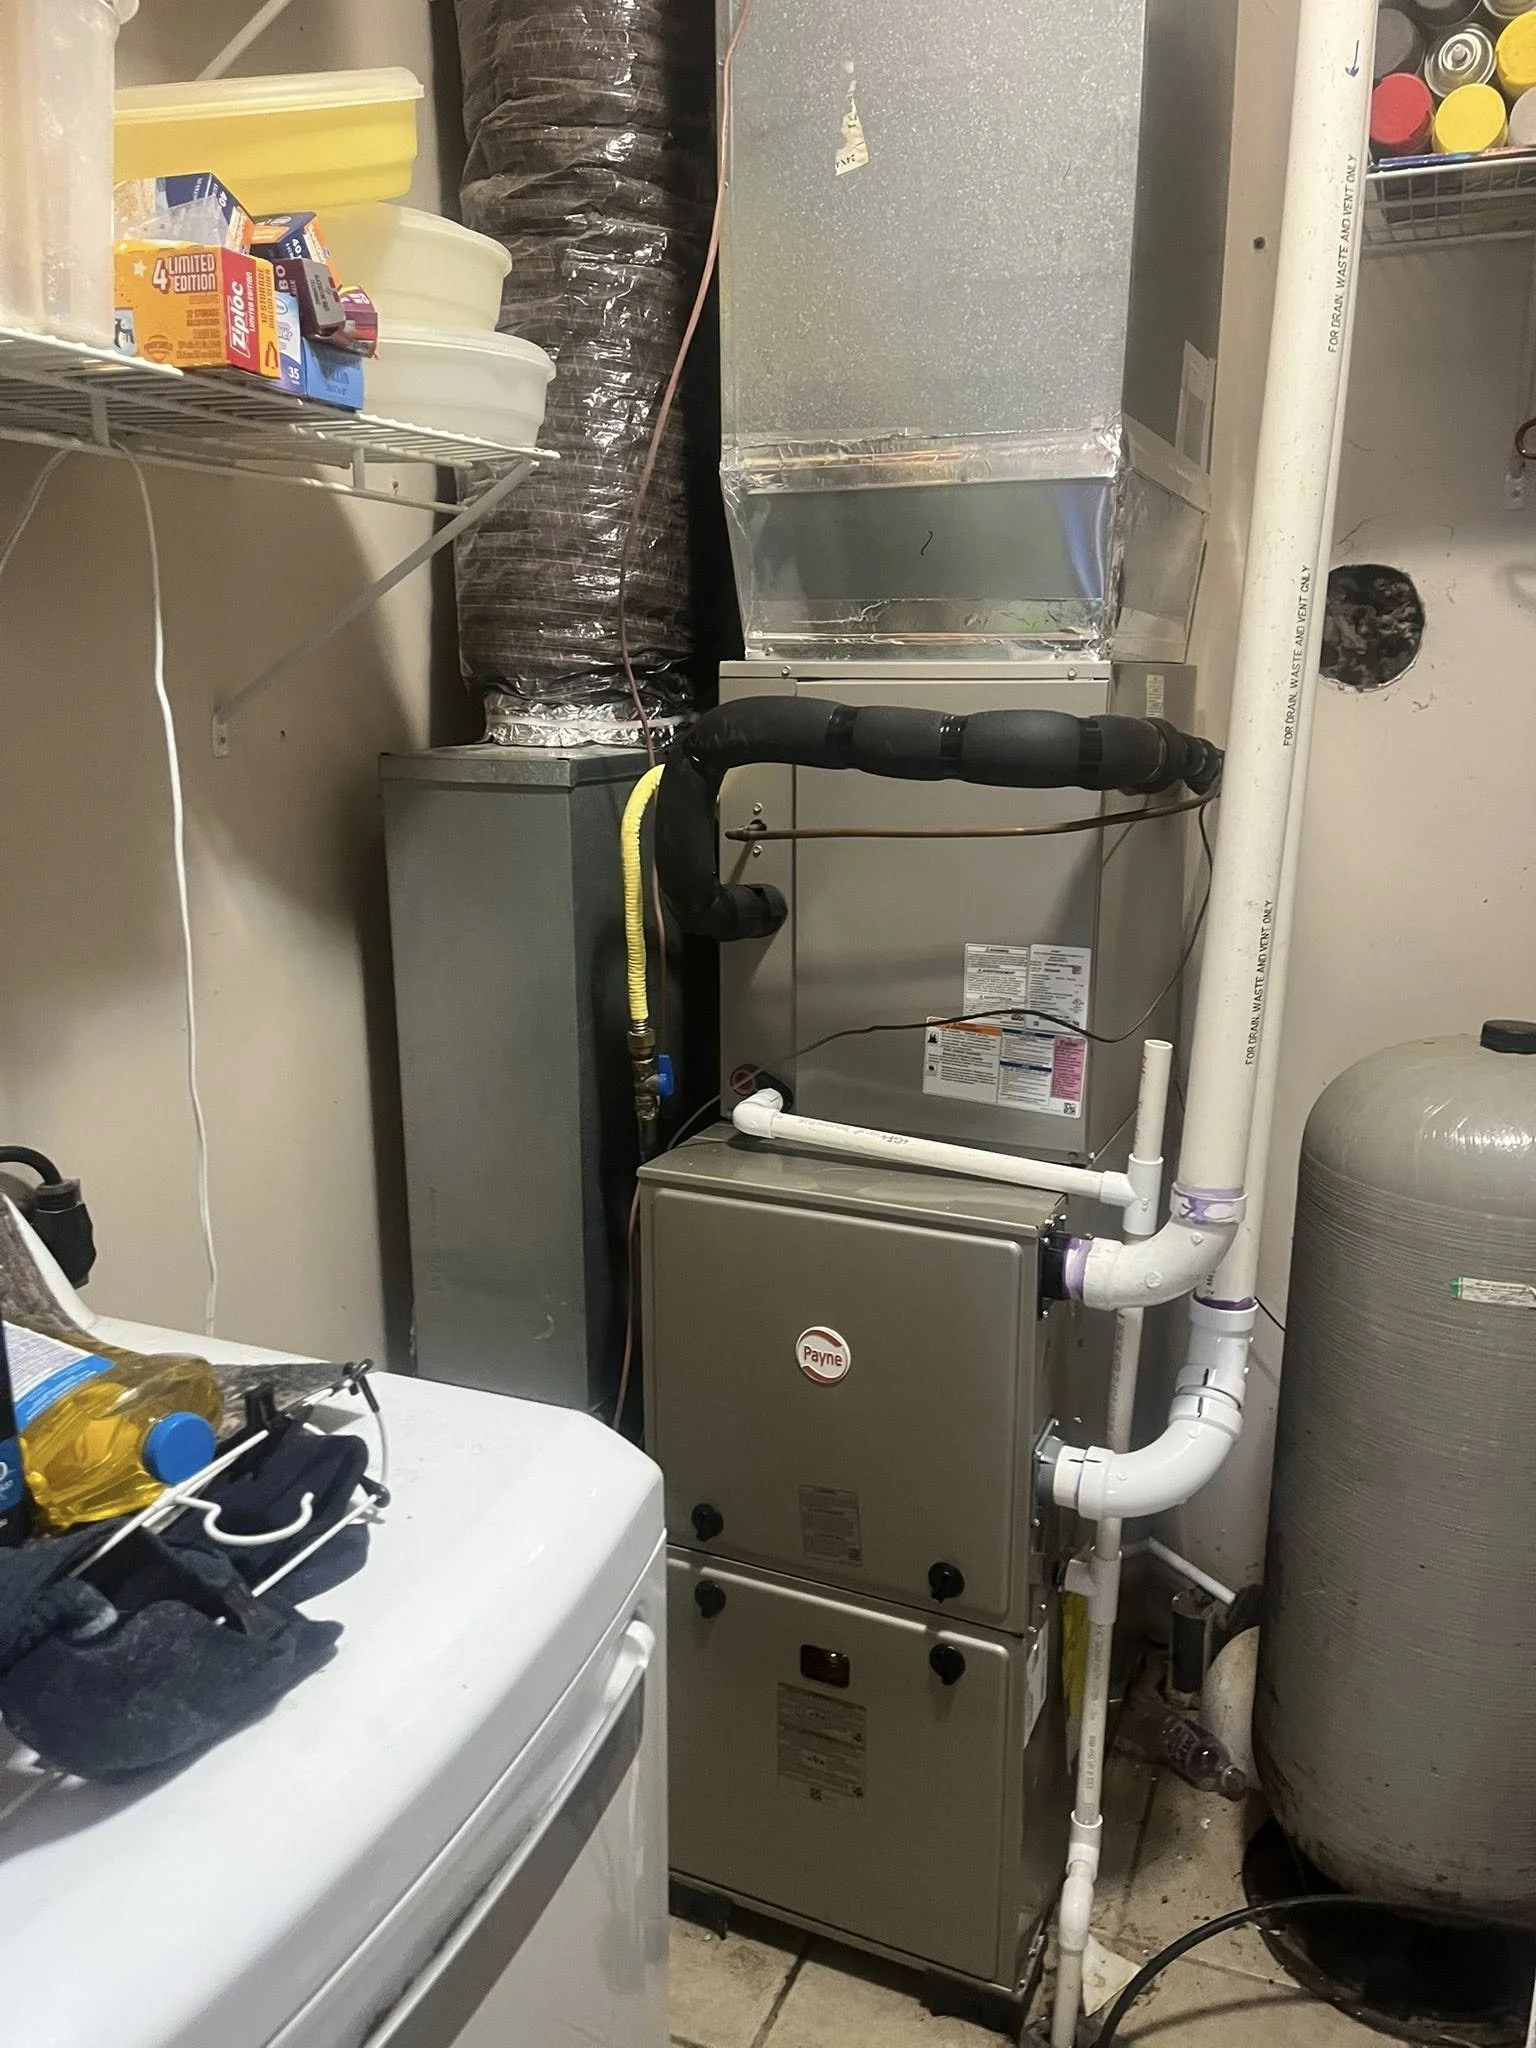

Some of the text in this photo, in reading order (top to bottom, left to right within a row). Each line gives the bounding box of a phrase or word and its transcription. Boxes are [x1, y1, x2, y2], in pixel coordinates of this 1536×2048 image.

[1347, 154, 1357, 184] ONLY
[1343, 187, 1352, 216] VENT
[1340, 218, 1351, 243] AND
[153, 259, 168, 290] 4
[168, 254, 216, 274] LIMITED
[1336, 245, 1349, 289] WASTE
[174, 273, 217, 293] EDITION
[230, 281, 248, 352] Ziploc
[247, 299, 256, 333] LIMITED
[1328, 329, 1339, 352] FOR
[288, 366, 299, 380] 35
[1300, 565, 1311, 593] ONLY
[1297, 596, 1307, 626] VENT
[1295, 625, 1304, 646] AND
[1290, 649, 1302, 690] WASTE
[1283, 725, 1294, 746] FOR
[1263, 900, 1273, 924] ONLY
[1259, 927, 1269, 953] VENT
[1257, 953, 1267, 974] AND
[1252, 976, 1264, 1013] WASTE
[1245, 1045, 1256, 1065] FOR
[804, 1345, 842, 1367] Payne
